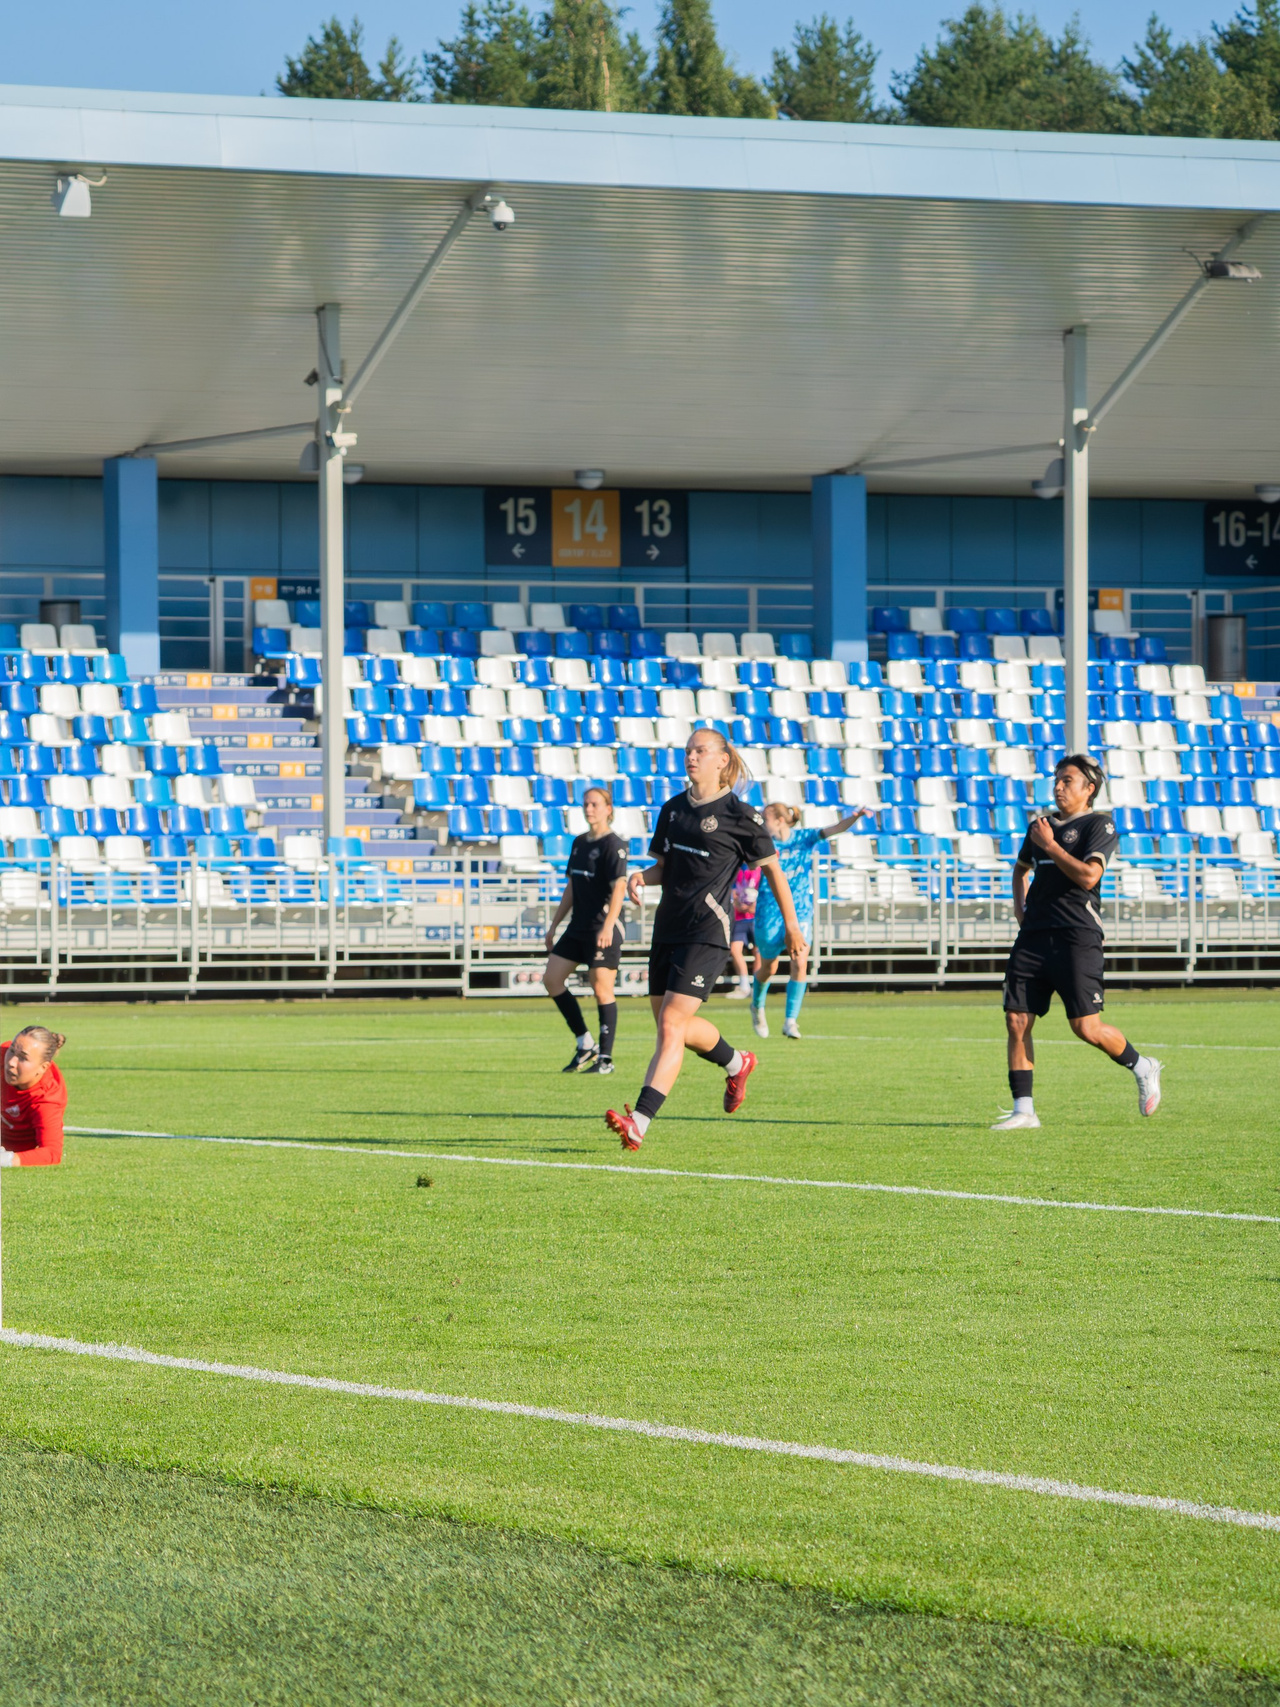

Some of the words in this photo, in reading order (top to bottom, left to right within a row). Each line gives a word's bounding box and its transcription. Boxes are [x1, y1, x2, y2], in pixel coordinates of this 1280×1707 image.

[499, 497, 538, 536] 15
[563, 498, 608, 543] 14
[634, 499, 672, 538] 13
